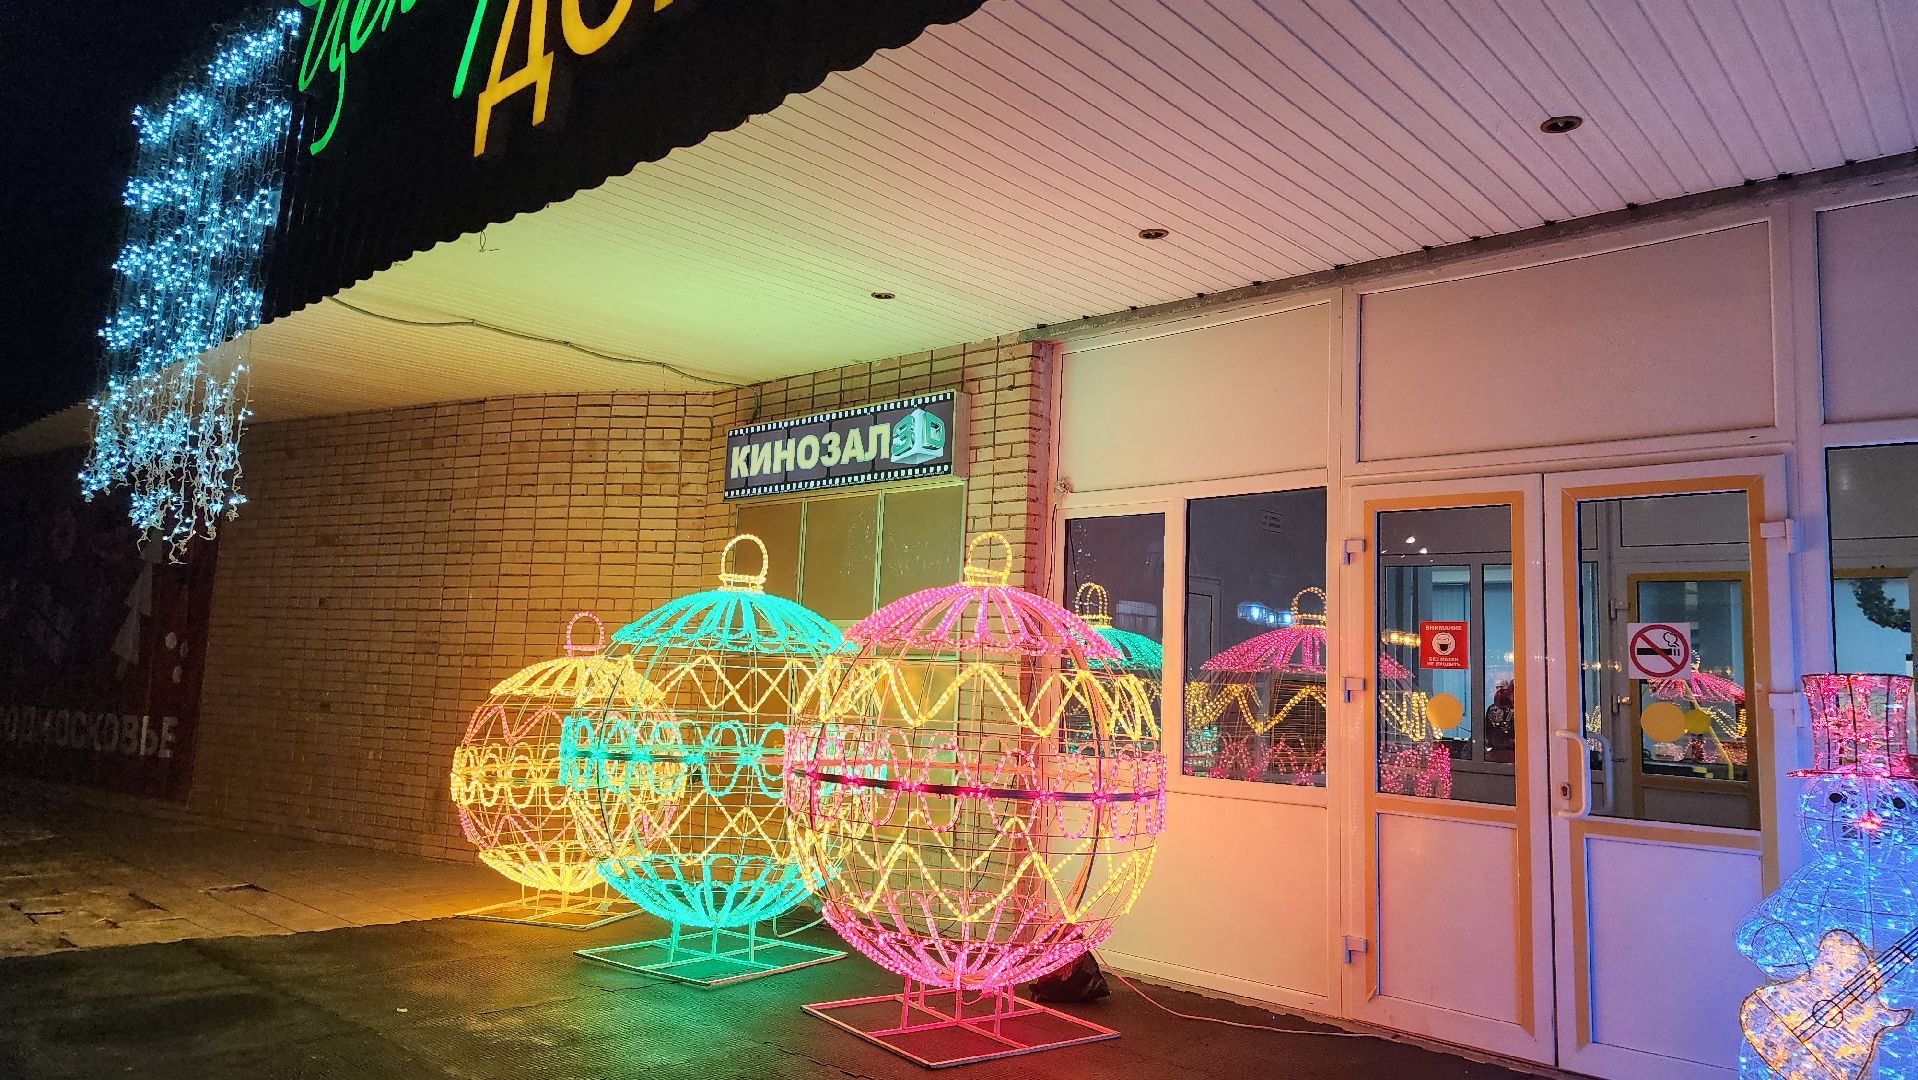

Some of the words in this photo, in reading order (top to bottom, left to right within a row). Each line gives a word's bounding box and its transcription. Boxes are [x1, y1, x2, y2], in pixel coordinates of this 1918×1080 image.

[730, 422, 890, 479] КИНОЗАЛ
[891, 410, 946, 457] 3D
[0, 704, 179, 758] ОДМОСКОВЬЕ
